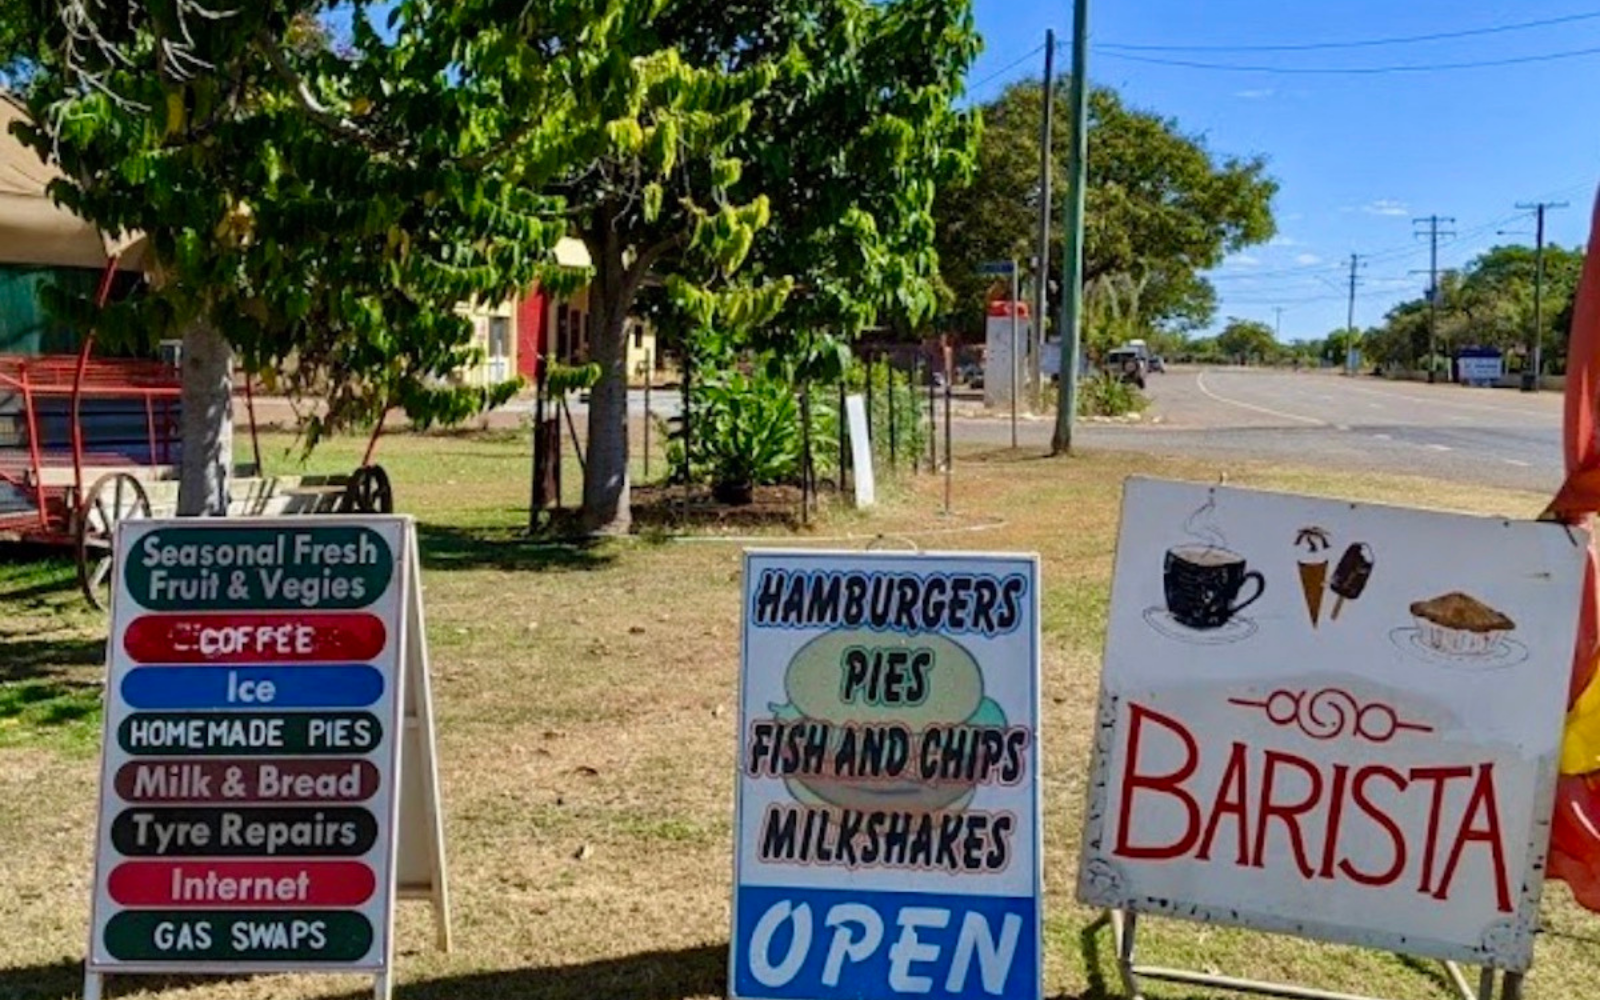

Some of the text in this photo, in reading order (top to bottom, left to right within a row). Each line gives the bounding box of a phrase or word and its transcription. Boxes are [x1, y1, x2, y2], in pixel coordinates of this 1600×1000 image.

[142, 533, 377, 567] Seasonal Fresh
[150, 568, 366, 606] Fruit & Vegies
[755, 570, 1024, 635] HAMBURGERS
[199, 625, 314, 655] COFFEE
[227, 671, 276, 703] Ice
[842, 649, 932, 703] PIES
[130, 718, 372, 748] HOMEMADE PIES
[750, 723, 1026, 782] FISH AND CHIPS
[133, 764, 361, 798] Milk & Bread
[1113, 701, 1514, 914] BARISTA
[133, 812, 356, 854] Tyre Repairs
[761, 808, 1011, 870] MILKSHAKES
[172, 867, 310, 901] Internet
[153, 920, 327, 951] GAS SWAPS
[749, 899, 1023, 995] OPEN
